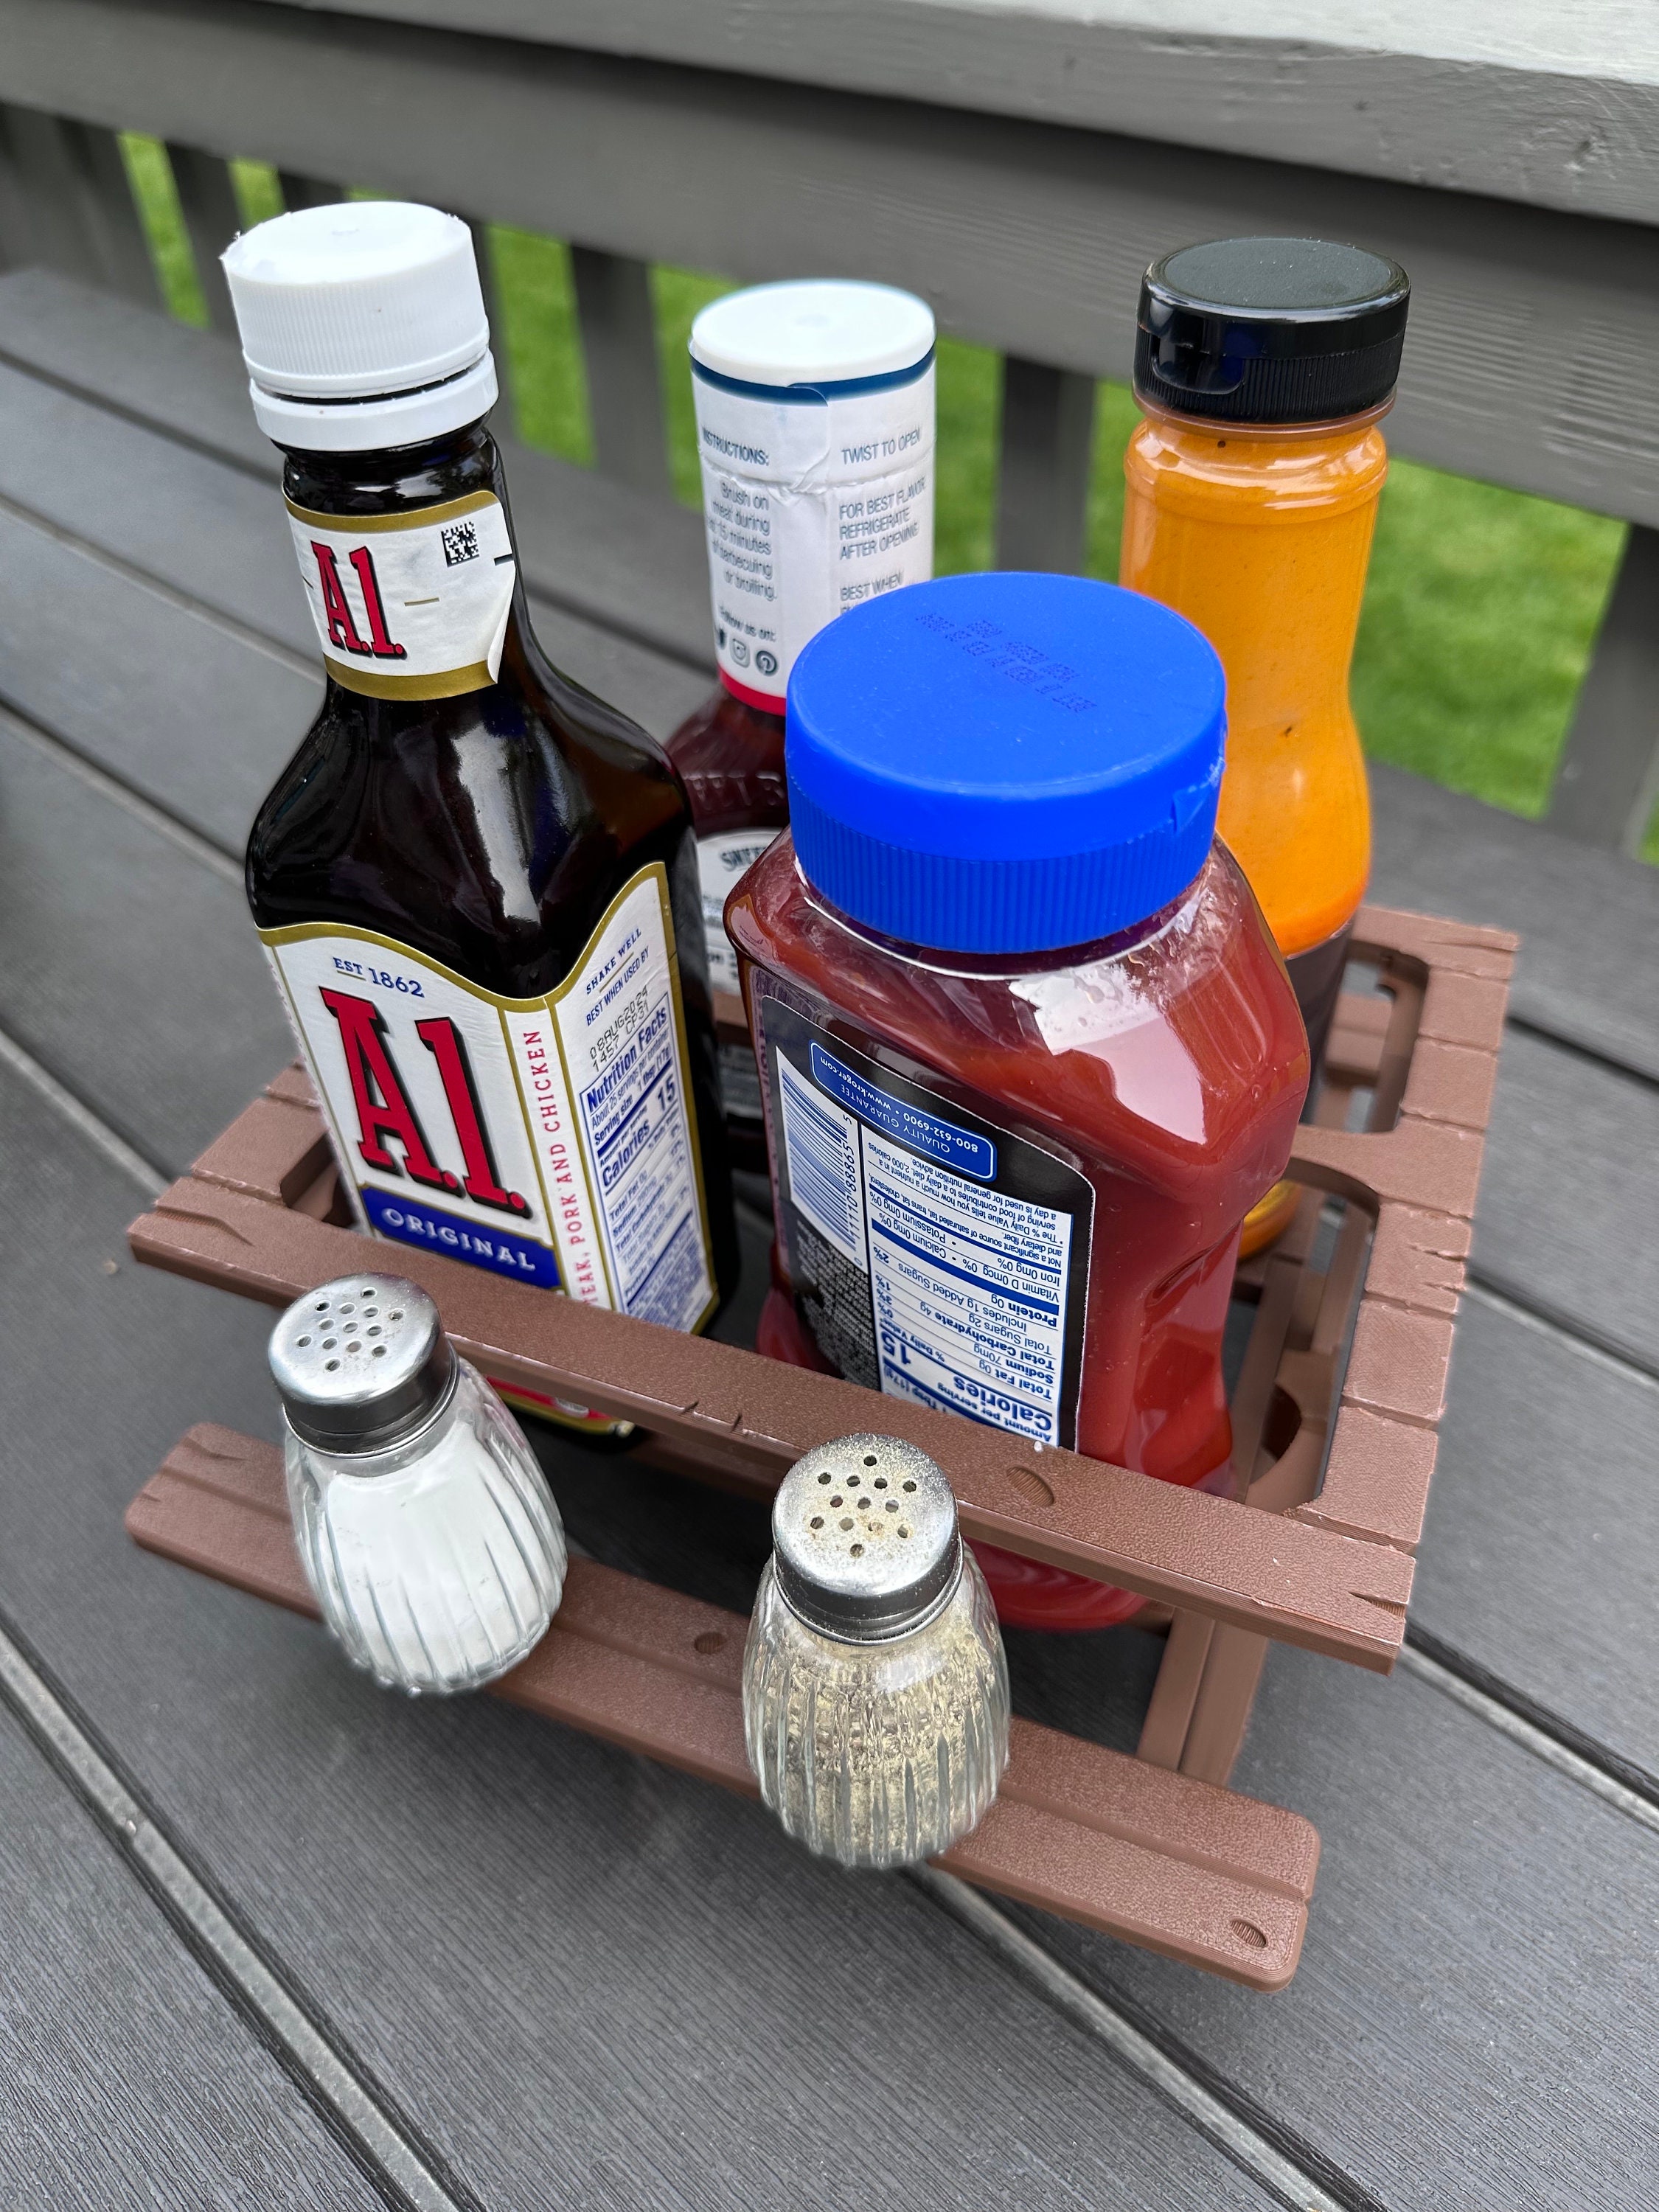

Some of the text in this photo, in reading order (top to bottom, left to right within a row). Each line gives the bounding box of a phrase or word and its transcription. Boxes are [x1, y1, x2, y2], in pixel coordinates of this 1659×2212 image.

[842, 427, 922, 465] TWIST TO OPEN
[754, 494, 770, 511] on
[840, 503, 863, 521] FOR
[867, 493, 894, 515] BEST
[840, 507, 911, 541] REFRIGERATE
[840, 540, 877, 561] AFTER
[841, 582, 871, 602] BEST
[587, 928, 642, 995] SHAKE WELL
[333, 957, 425, 998] EST 1862
[586, 945, 648, 1028] BEST WHEN USED BY
[589, 982, 647, 1064] 08AUG2024
[586, 1001, 667, 1115] Nutrition Facts
[818, 1054, 891, 1110] www.kroger.com
[591, 1102, 610, 1133] About
[608, 1091, 617, 1111] 25
[616, 1065, 639, 1102] servings
[594, 1107, 620, 1151] Serving
[619, 1091, 633, 1116] size
[637, 1079, 641, 1093] 1
[838, 1082, 950, 1154] QUALITY GUARANTEE
[843, 1111, 852, 1127] 5
[602, 1114, 650, 1190] Calories
[656, 1071, 676, 1116] 15
[902, 1111, 978, 1153] 800-632-6900
[599, 1138, 620, 1169] Amount
[868, 1141, 891, 1162] calories
[891, 1156, 909, 1172] 2,000
[523, 1032, 599, 1305] TEAK, PORK AND CHICKEN
[842, 1140, 856, 1194] 88865
[910, 1158, 933, 1174] advice.
[935, 1169, 961, 1189] nutrition
[868, 1172, 900, 1200] cholesterol,
[925, 1174, 942, 1190] daily
[949, 1187, 956, 1197] to
[964, 1183, 990, 1200] general
[877, 1158, 1057, 1242] The % Daily Value tells you how much a nutrient in a
[911, 1200, 926, 1215] trans
[958, 1191, 997, 1213] contributes
[992, 1195, 1002, 1205] for
[999, 1208, 1015, 1219] food
[1004, 1199, 1023, 1212] used
[1025, 1206, 1032, 1215] is
[846, 1193, 860, 1242] 11110
[927, 1207, 937, 1221] fat,
[939, 1214, 969, 1234] saturated
[1017, 1214, 1025, 1222] of
[1027, 1214, 1055, 1231] serving
[1034, 1208, 1048, 1220] day
[381, 1208, 536, 1271] ORIGINAL
[869, 1190, 1060, 1287] Iron 0mg 0% Potassium 0mg 0%
[970, 1228, 977, 1239] of
[978, 1232, 1001, 1247] source
[1001, 1231, 1062, 1257] and dietary fiber.
[879, 1211, 1059, 1303] Vitamin D 0mcg 0% Calcium 0mg 0%
[1004, 1242, 1039, 1260] significant
[1047, 1256, 1061, 1267] Not
[872, 1245, 1026, 1332] Includes 1g Added Sugars 2%
[874, 1273, 891, 1292] 1%
[877, 1301, 893, 1318] 0%
[990, 1292, 1057, 1327] Protein 0g
[910, 1335, 932, 1355] Daily
[919, 1300, 1054, 1370] Total Carbohydrate 4g
[968, 1311, 1052, 1355] Total Sugars 2g
[880, 1330, 911, 1366] 15
[973, 1342, 1053, 1385] Sodium 70mg
[978, 1359, 1051, 1399] Total Fat 0g
[937, 1381, 977, 1410] serving
[953, 1375, 1051, 1433] Calories
[981, 1407, 999, 1420] per
[1004, 1417, 1050, 1442] Amount
